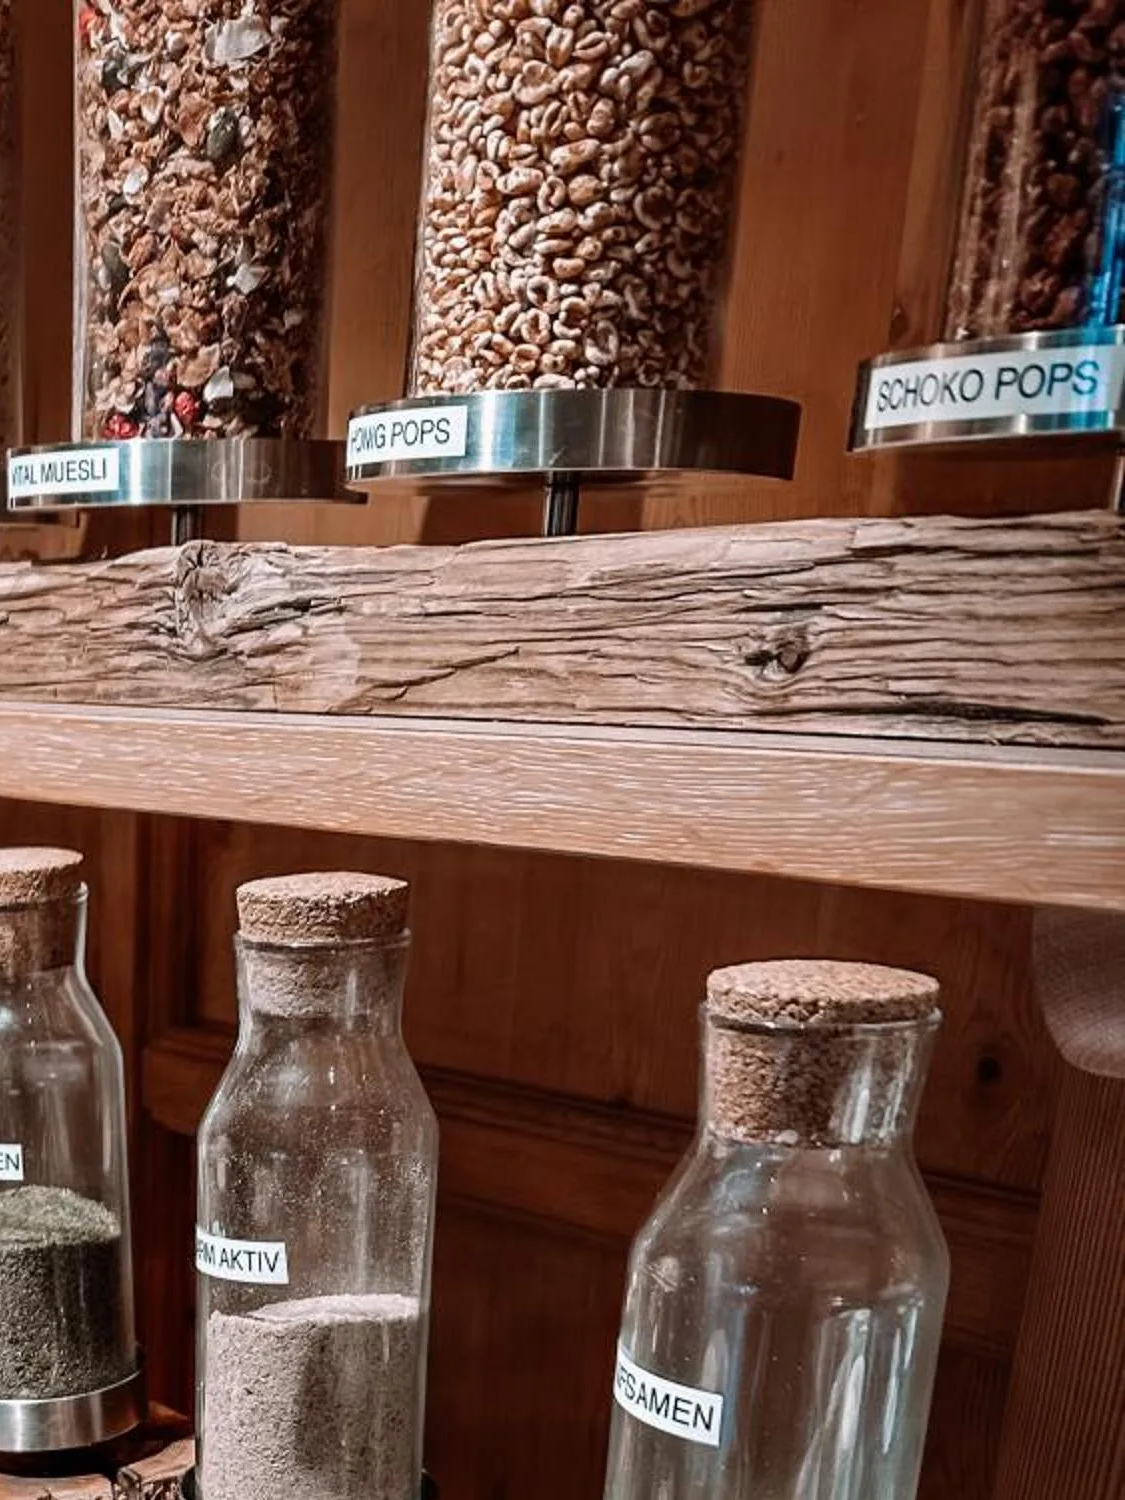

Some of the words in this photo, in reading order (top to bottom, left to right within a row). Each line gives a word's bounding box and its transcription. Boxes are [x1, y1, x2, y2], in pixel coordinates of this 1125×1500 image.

[877, 369, 985, 413] SCHOKO
[994, 359, 1100, 401] POPS
[390, 417, 450, 447] POPS
[40, 457, 107, 483] MUESLI
[218, 1248, 279, 1273] AKTIV
